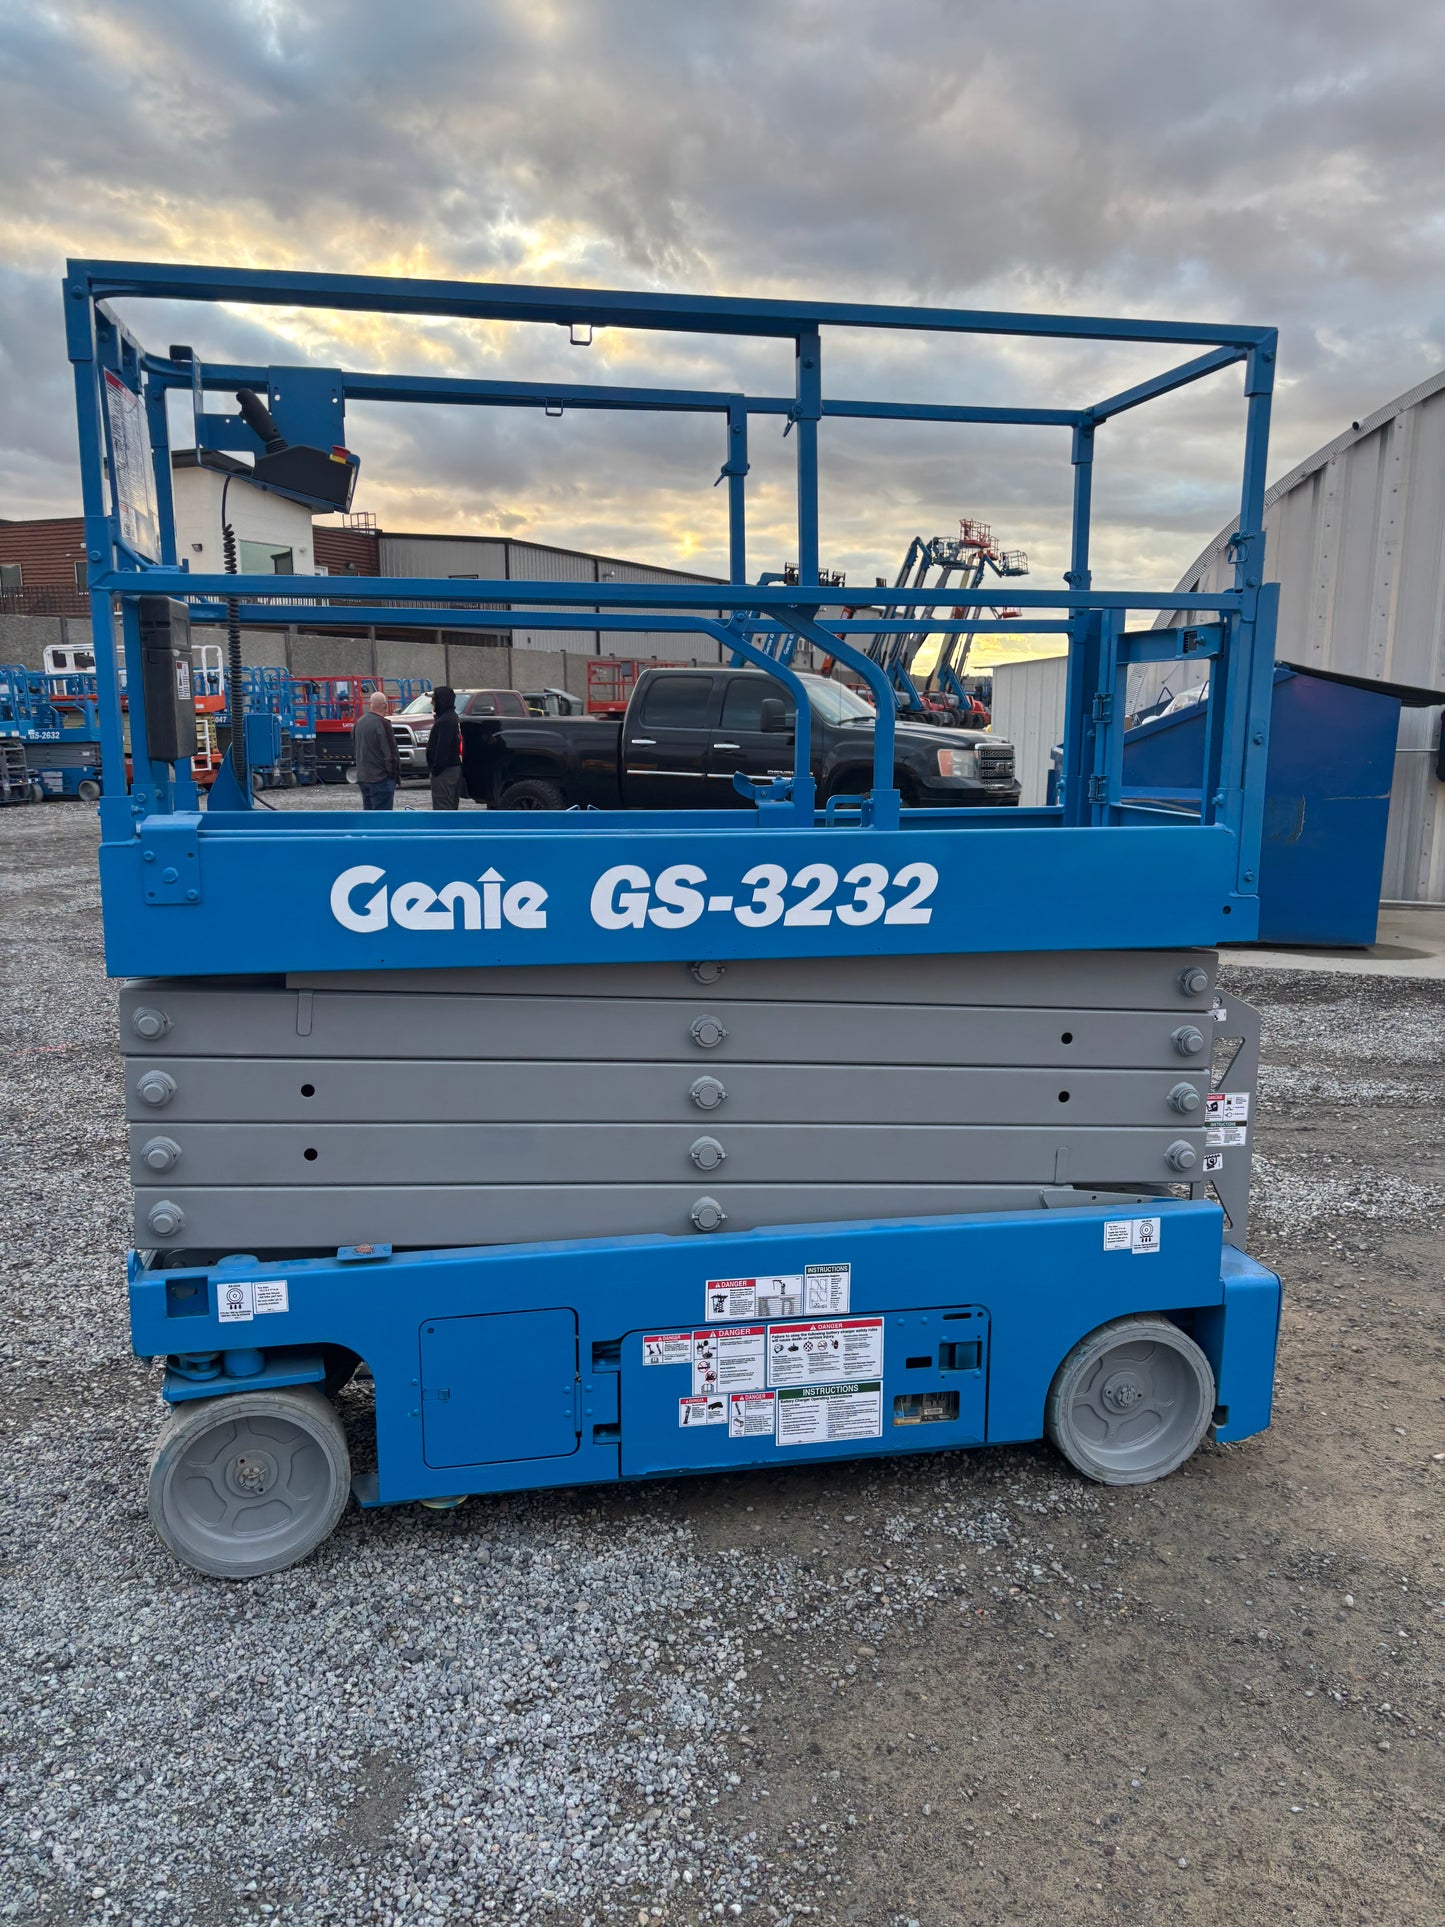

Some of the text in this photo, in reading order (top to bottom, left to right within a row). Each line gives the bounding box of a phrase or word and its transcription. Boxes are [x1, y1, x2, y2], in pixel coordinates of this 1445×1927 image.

[330, 862, 939, 933] Genie GS-3232
[807, 1265, 849, 1273] INSTRUCTIONS
[721, 1280, 748, 1288] DANGER
[719, 1328, 751, 1337] DANGER
[802, 1385, 859, 1396] INSTRUCTIONS
